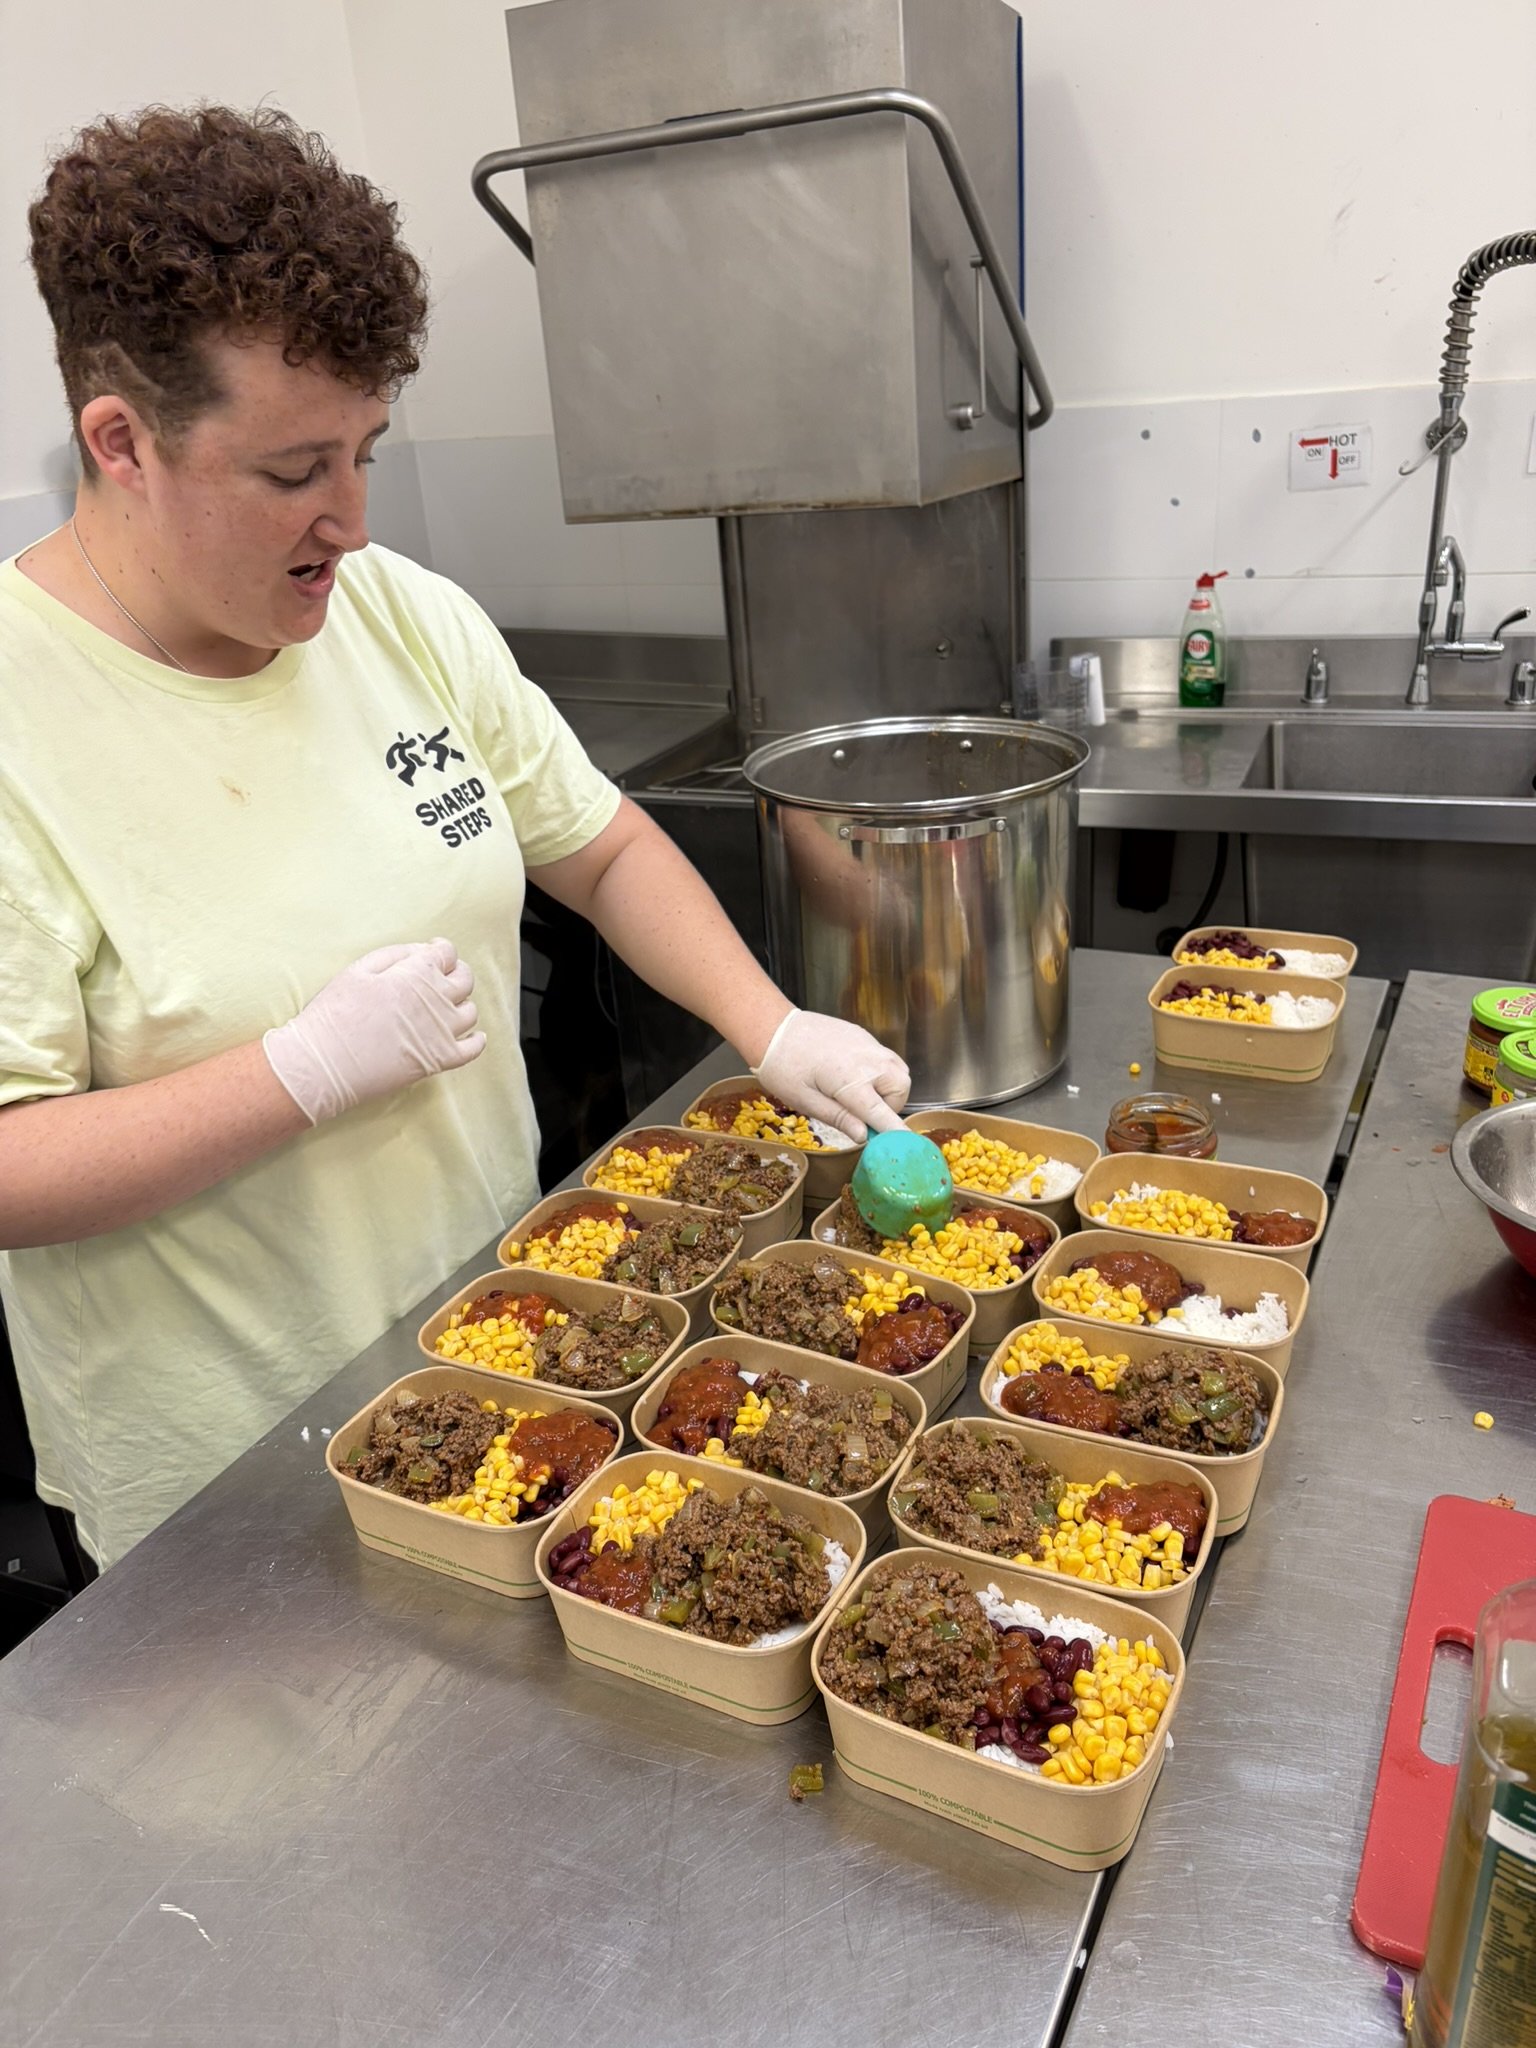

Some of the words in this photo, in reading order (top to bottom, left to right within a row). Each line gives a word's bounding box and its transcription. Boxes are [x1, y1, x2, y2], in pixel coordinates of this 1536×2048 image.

[1329, 433, 1357, 446] HOT
[1307, 448, 1322, 457] ON
[1338, 455, 1356, 465] OFF
[415, 777, 486, 826] SHARED
[440, 806, 492, 848] STEPS
[918, 1788, 939, 1802] 100%
[940, 1797, 993, 1824] COMPOSTABLE
